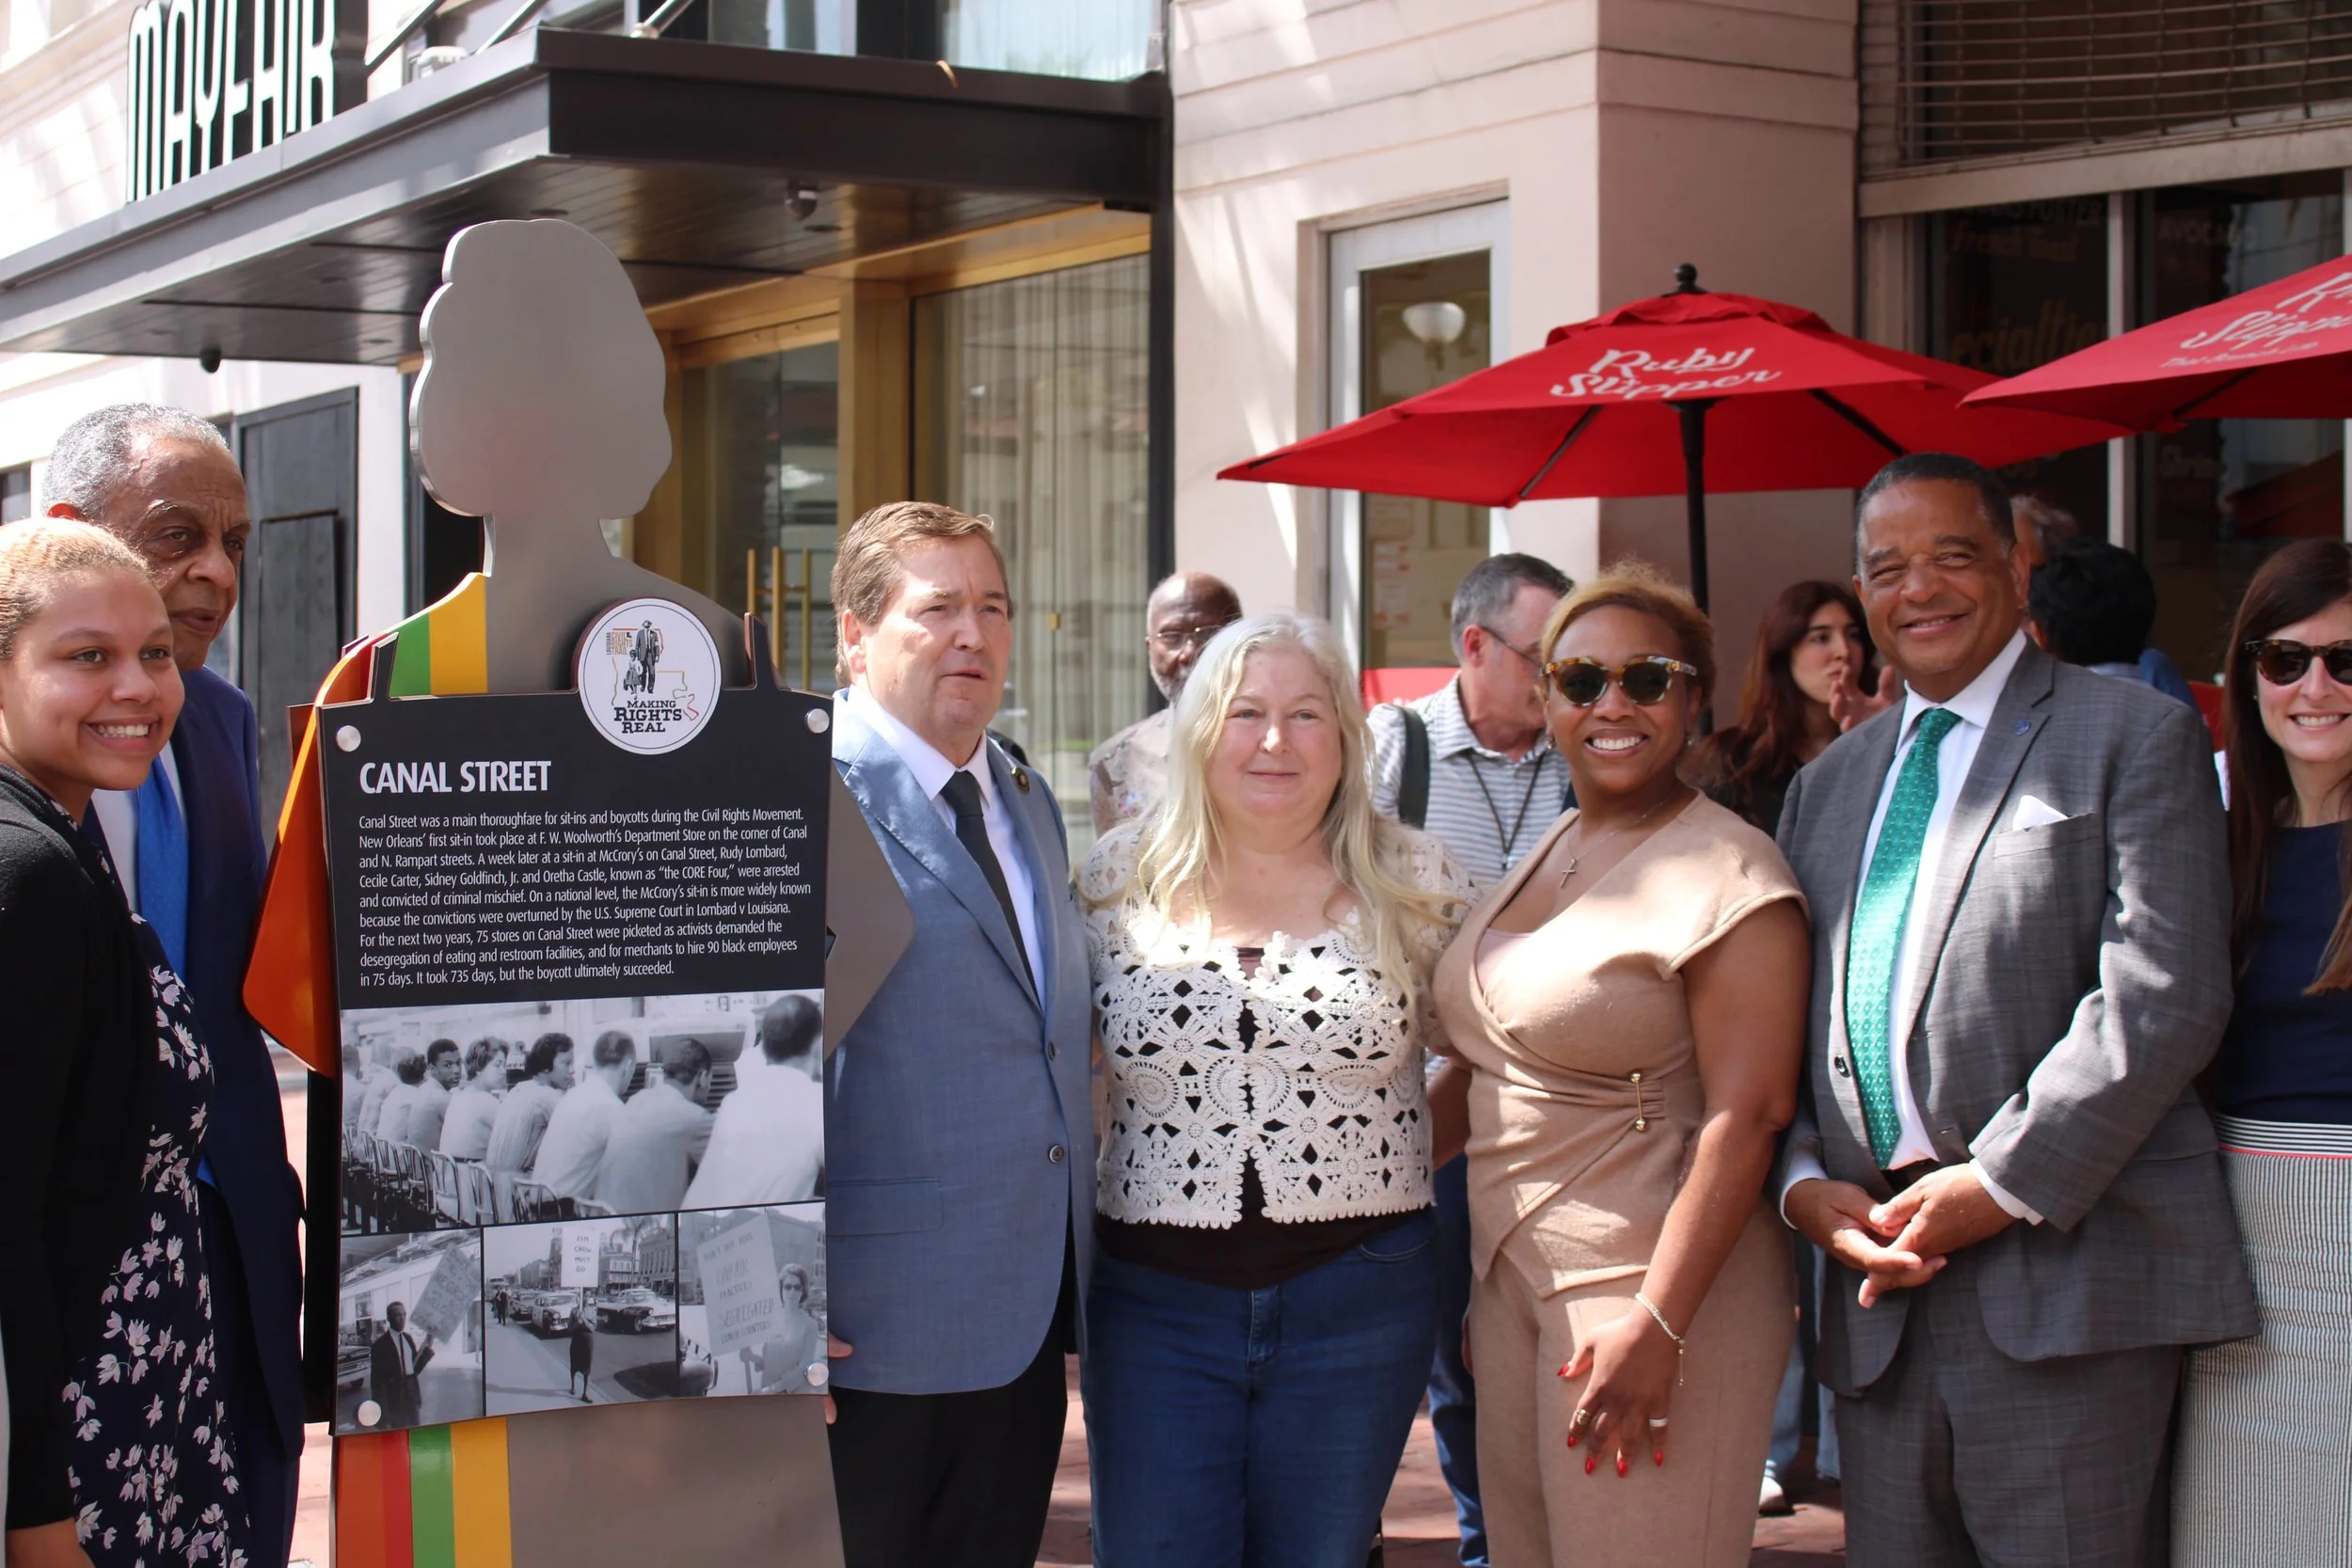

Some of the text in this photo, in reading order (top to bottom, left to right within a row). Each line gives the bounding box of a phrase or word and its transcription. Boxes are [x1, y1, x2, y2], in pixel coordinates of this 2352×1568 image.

[126, 0, 336, 203] MAYFAIR
[1588, 347, 1756, 379] Ruby
[1549, 371, 1782, 400] Slipper
[614, 707, 682, 721] RIGHTS
[622, 721, 666, 734] REAL
[359, 760, 551, 794] CANAL STREET
[359, 808, 803, 829] Canal Street was a main thoroughfare for sit-ins and boycotts during the Civil Rights Movement.
[359, 836, 383, 848] New
[429, 833, 447, 847] first
[450, 833, 472, 847] sit-in
[476, 832, 497, 846] took
[501, 832, 525, 848] place
[528, 832, 536, 845] at
[540, 832, 546, 844] F.
[549, 832, 561, 844] W.
[625, 830, 680, 845] Department
[683, 829, 706, 841] Store
[708, 831, 720, 840] on
[723, 827, 738, 839] the
[741, 830, 769, 839] corner
[771, 826, 781, 839] of
[783, 825, 807, 839] Canal
[359, 854, 378, 867] and
[382, 855, 391, 867] N.
[396, 854, 437, 869] Rampart
[440, 853, 474, 865] streets.
[478, 853, 485, 864] A
[488, 850, 516, 864] week
[518, 850, 539, 863] later
[542, 851, 551, 863] at
[554, 853, 559, 863] a
[563, 850, 584, 863] sit-in
[587, 850, 596, 862] at
[646, 850, 658, 861] on
[661, 847, 686, 860] Canal
[689, 847, 717, 862] Street,
[721, 846, 743, 862] Rudy
[746, 845, 787, 860] Lombard,
[359, 874, 388, 888] Cecile
[391, 875, 421, 888] Carter,
[425, 872, 457, 888] Sidney
[460, 870, 507, 886] Goldfinch,
[510, 871, 518, 887] Jr.
[522, 869, 540, 883] and
[544, 868, 574, 882] Oretha
[578, 867, 607, 883] Castle,
[611, 867, 642, 880] known
[645, 870, 656, 879] as
[682, 866, 706, 879] CORE
[738, 867, 760, 877] were
[764, 863, 800, 877] arrested
[360, 894, 378, 908] and
[382, 892, 427, 907] convicted
[431, 892, 440, 905] of
[444, 890, 481, 905] criminal
[485, 889, 526, 903] mischief.
[530, 890, 543, 902] On
[546, 892, 551, 901] a
[555, 887, 592, 901] national
[596, 886, 619, 902] level,
[623, 886, 638, 899] the
[687, 884, 707, 897] sit-in
[711, 884, 718, 896] is
[721, 886, 744, 895] more
[747, 882, 777, 898] widely
[780, 881, 811, 895] known
[360, 901, 790, 927] because the convictions were overturned by the U.S. Supreme Court in Lombard v Louisiana.
[360, 919, 782, 947] For the next two years, 75 stores on Canal Street were picketed as activists demanded the
[360, 938, 797, 969] desegregation of eating and restroom facilities, and for merchants to hire 90 black employees
[361, 960, 674, 988] in 75 days. It took 735 days, but the boycott ultimately succeeded.
[718, 1297, 774, 1330] SEGREGATED
